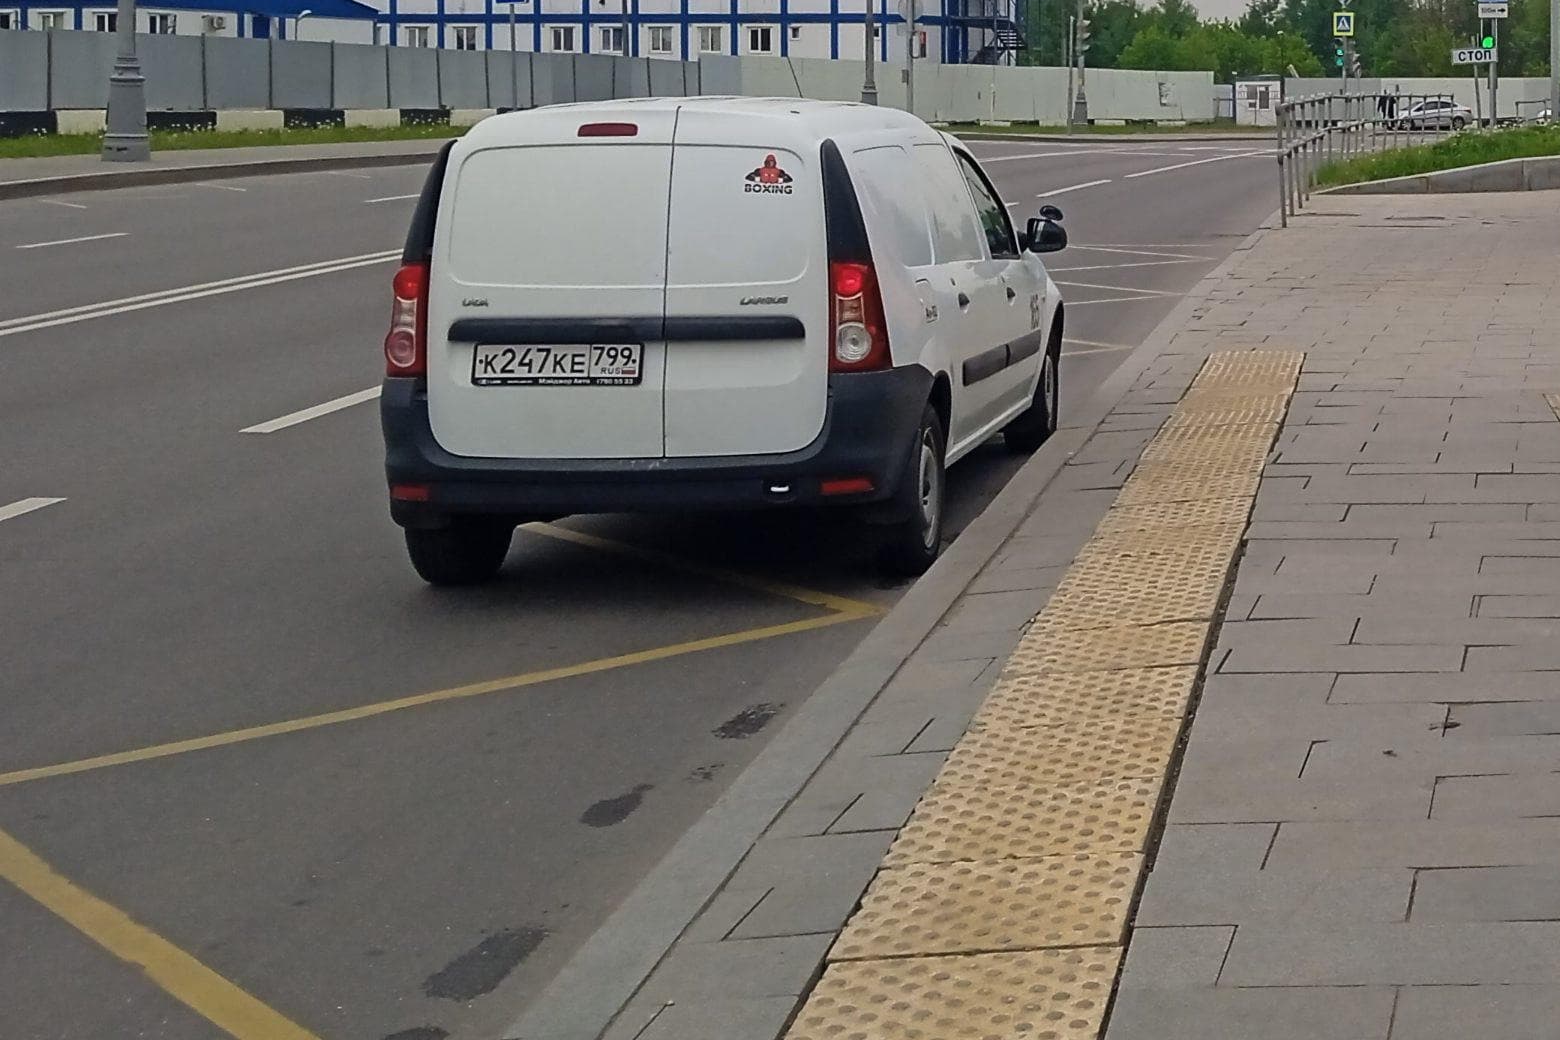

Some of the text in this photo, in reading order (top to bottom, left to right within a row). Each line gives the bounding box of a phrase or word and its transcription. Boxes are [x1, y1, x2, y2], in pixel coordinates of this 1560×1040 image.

[1458, 50, 1491, 62] СТОП
[744, 183, 793, 195] BOXING
[483, 347, 632, 374] К247КЕ 799
[601, 367, 620, 375] RUS
